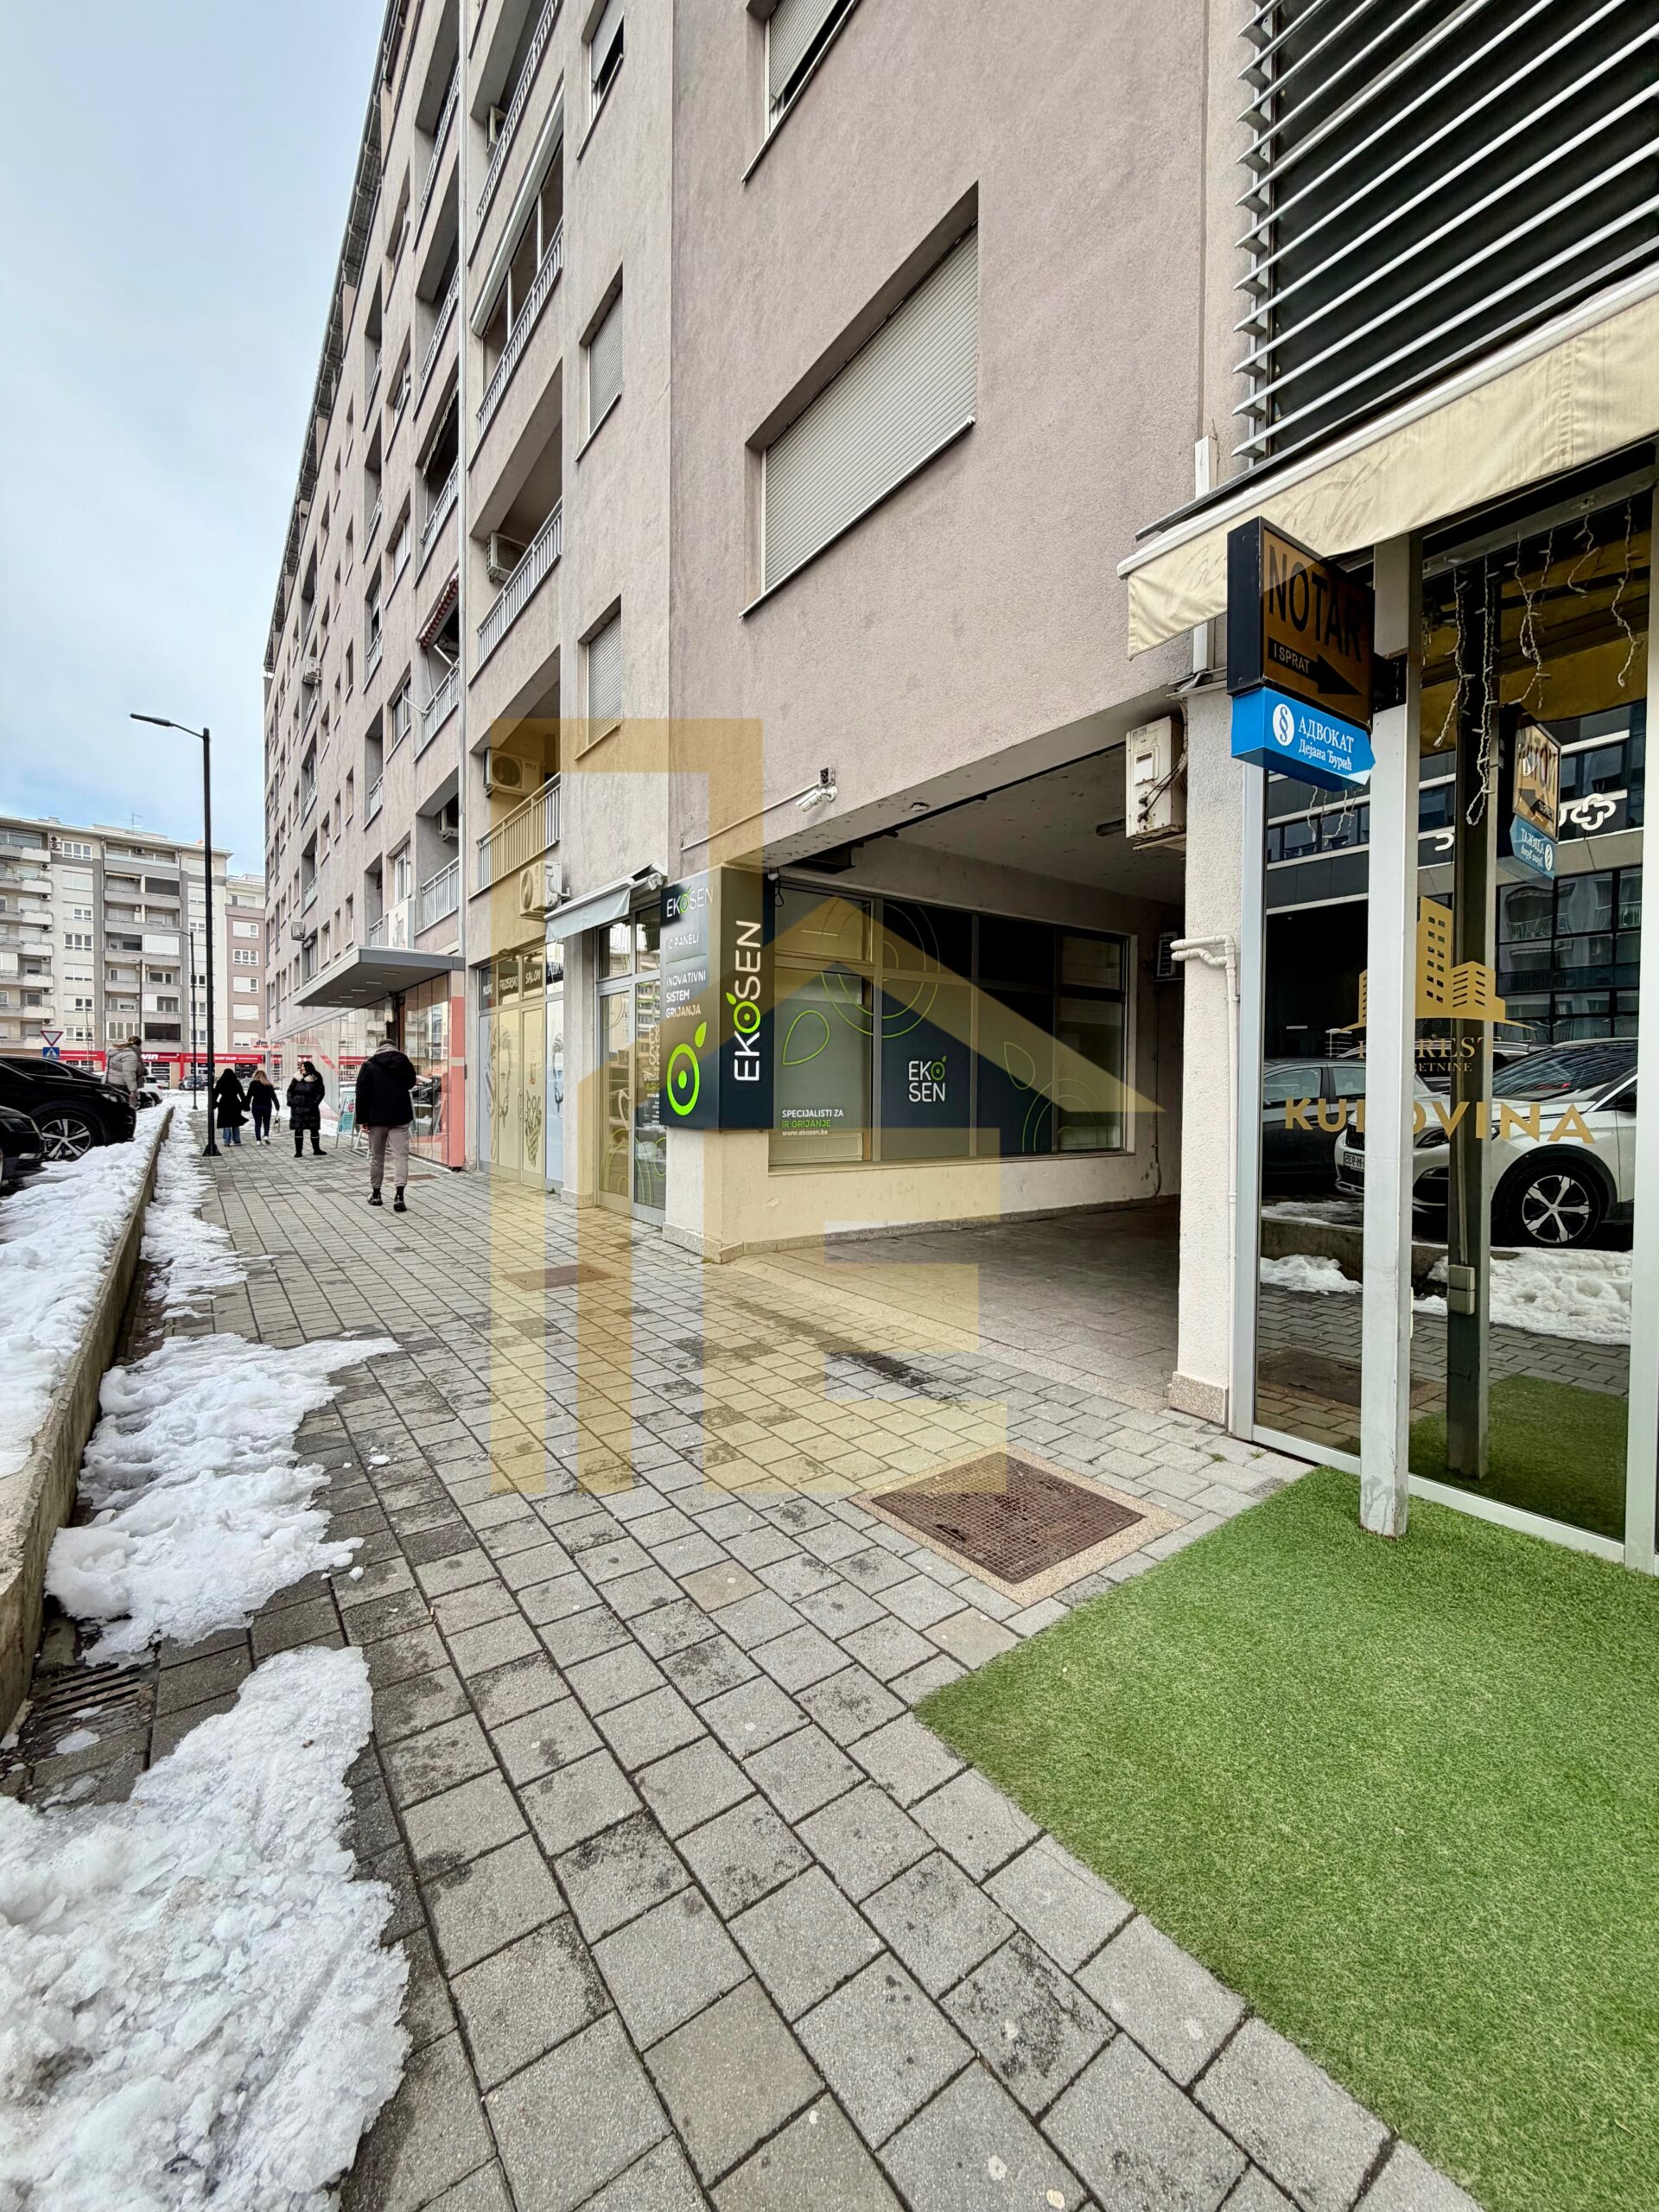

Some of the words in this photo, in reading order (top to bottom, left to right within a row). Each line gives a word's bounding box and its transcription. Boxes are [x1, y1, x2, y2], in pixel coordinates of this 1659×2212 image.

[1269, 544, 1363, 663] NOTAR
[1279, 645, 1310, 674] SPRAT
[1298, 715, 1355, 753] АДВОКАТ
[1298, 738, 1325, 761] Дејана
[666, 885, 715, 918] EKOSEN
[674, 933, 699, 947] PANELI
[666, 969, 706, 987] INOVATIVNI
[665, 989, 690, 1002] SISTEM
[733, 919, 762, 1082] EKOSEN
[665, 1004, 702, 1018] GRIJANJA
[908, 1059, 945, 1082] EKO
[908, 1082, 945, 1103] SEN
[781, 1109, 832, 1118] SPECIJALISTI
[833, 1109, 844, 1117] ZA
[791, 1119, 831, 1128] GRIJANJE
[1285, 1097, 1596, 1144] KUVINA
